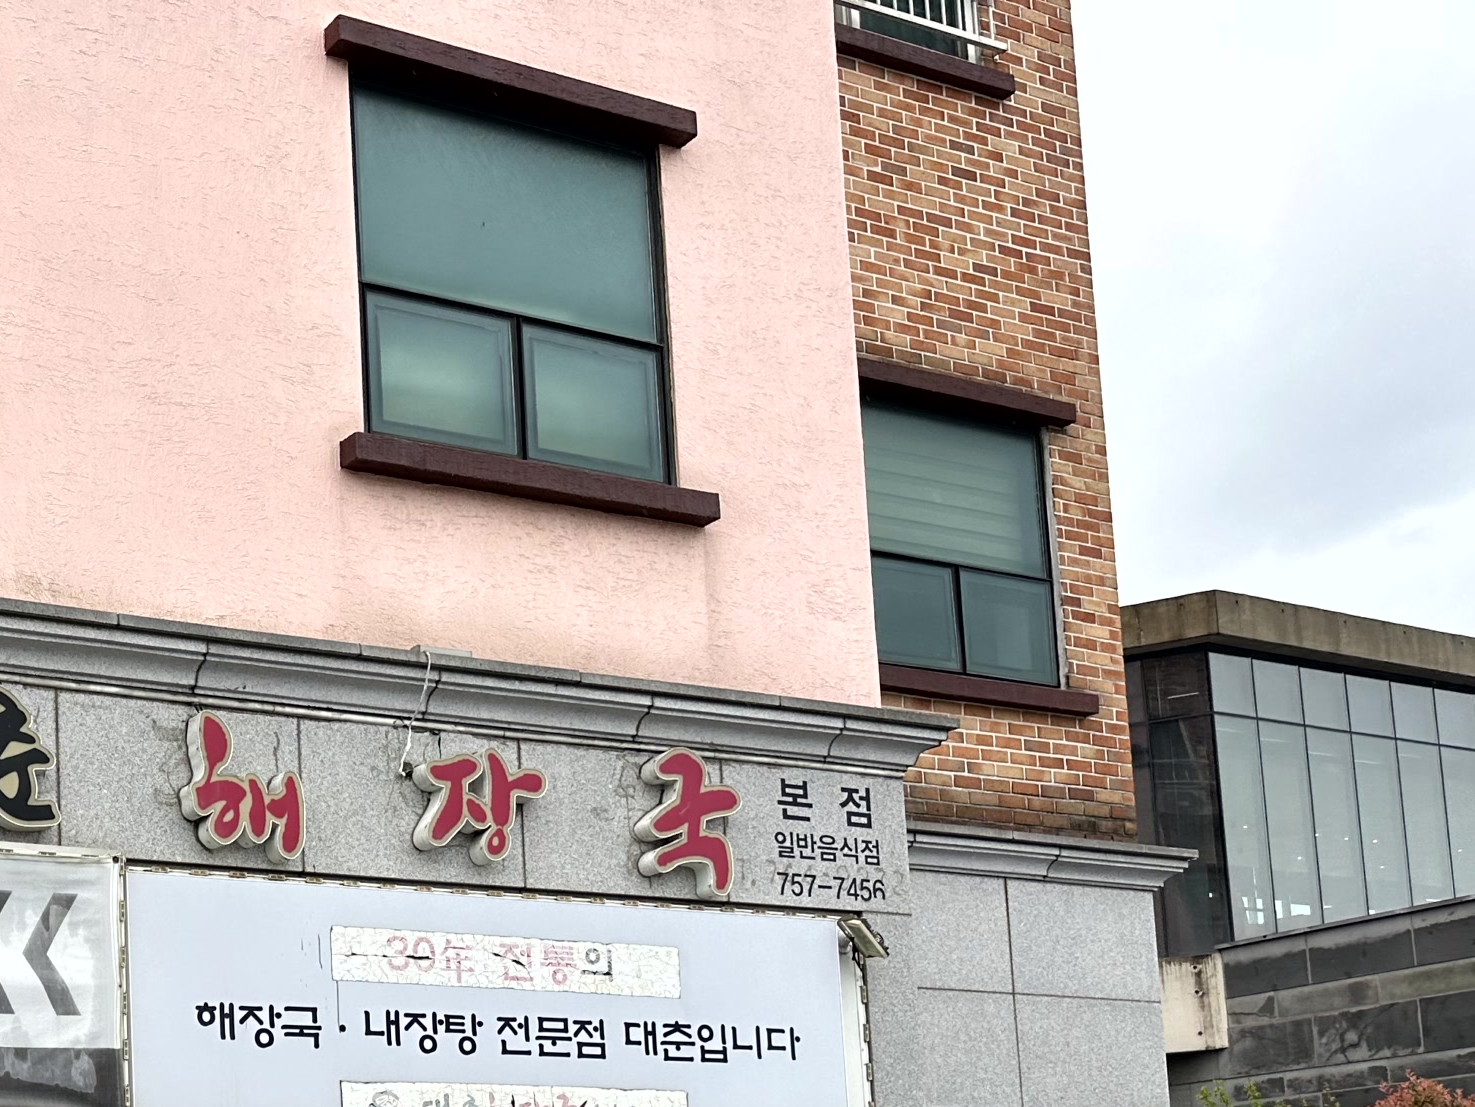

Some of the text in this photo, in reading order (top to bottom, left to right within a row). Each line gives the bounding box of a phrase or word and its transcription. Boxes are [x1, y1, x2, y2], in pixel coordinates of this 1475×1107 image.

[774, 831, 881, 866] 일반음식점
[776, 871, 886, 901] 757-7456
[195, 1000, 801, 1064] 해장국 내장탕 전문점 대춘입니다
